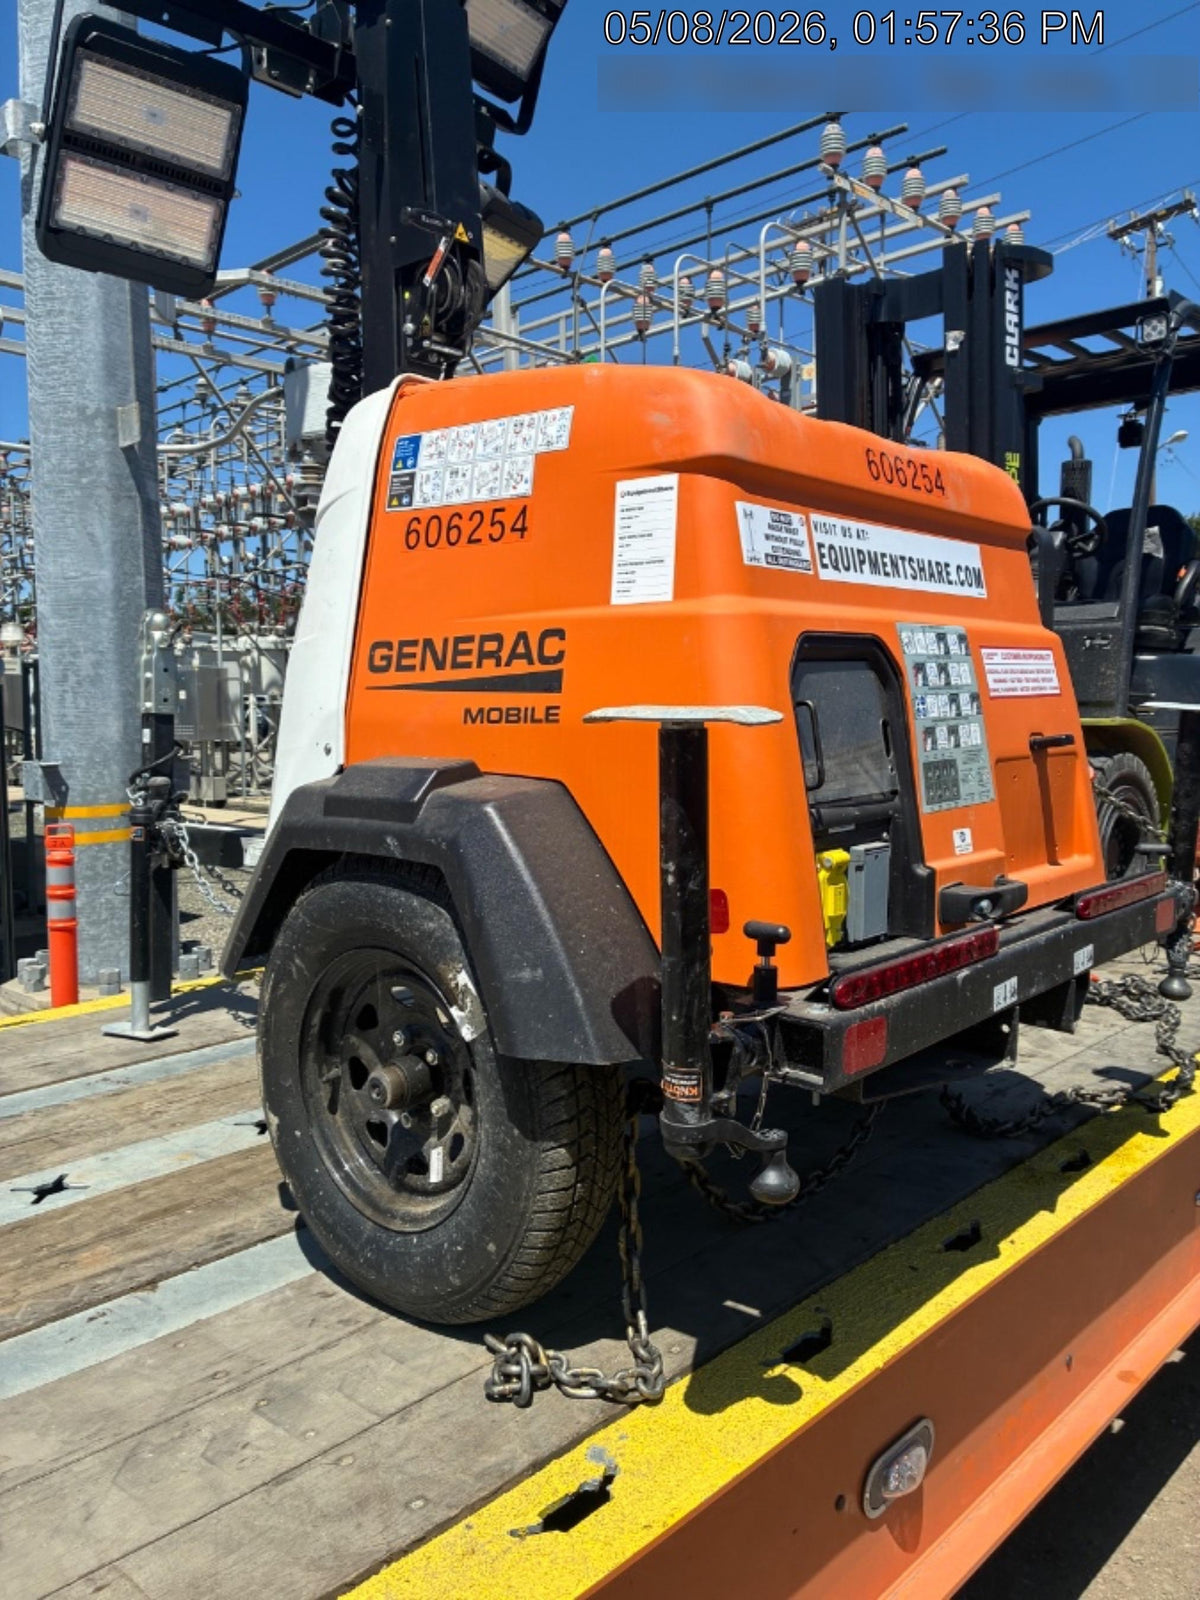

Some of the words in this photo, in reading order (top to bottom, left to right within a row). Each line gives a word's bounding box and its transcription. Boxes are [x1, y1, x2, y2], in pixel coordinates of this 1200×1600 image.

[1004, 267, 1020, 367] CLARK
[865, 448, 945, 496] 606254
[404, 505, 529, 550] 606254
[812, 520, 837, 536] VISIT
[841, 525, 853, 539] US
[816, 541, 984, 589] EQUIPMENTSHARE.COM
[367, 627, 567, 674] GENERAC
[462, 705, 561, 724] MOBILE
